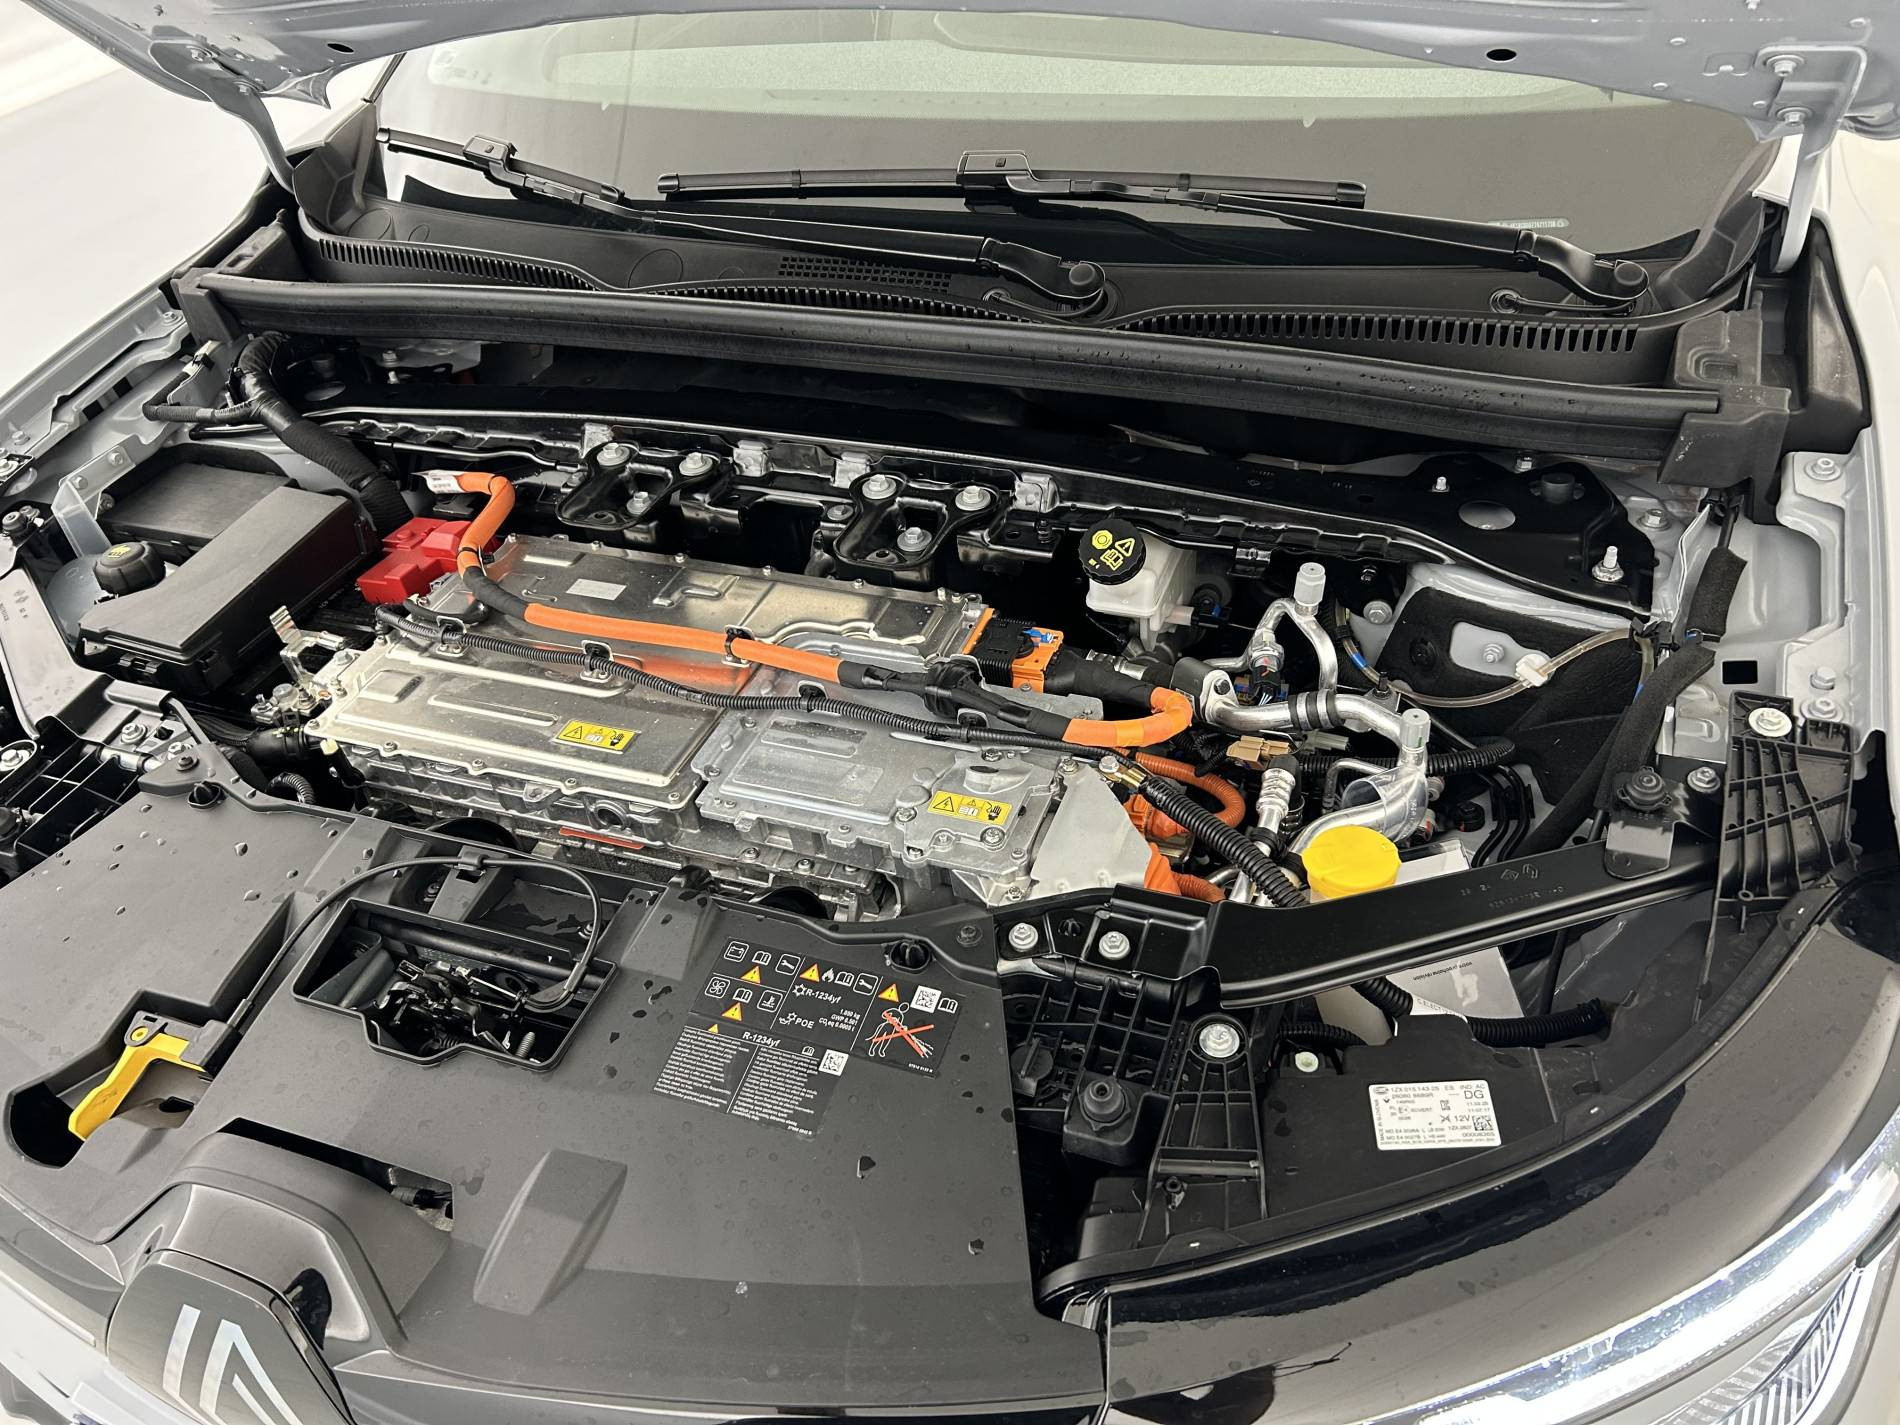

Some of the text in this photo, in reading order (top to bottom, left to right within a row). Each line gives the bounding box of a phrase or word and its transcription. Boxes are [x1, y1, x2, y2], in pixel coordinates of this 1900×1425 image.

[805, 988, 842, 1004] R-1234yf
[795, 1017, 815, 1029] POE
[742, 1031, 781, 1047] R-1234yf
[1463, 1089, 1485, 1100] DG
[1454, 1114, 1470, 1122] 12V
